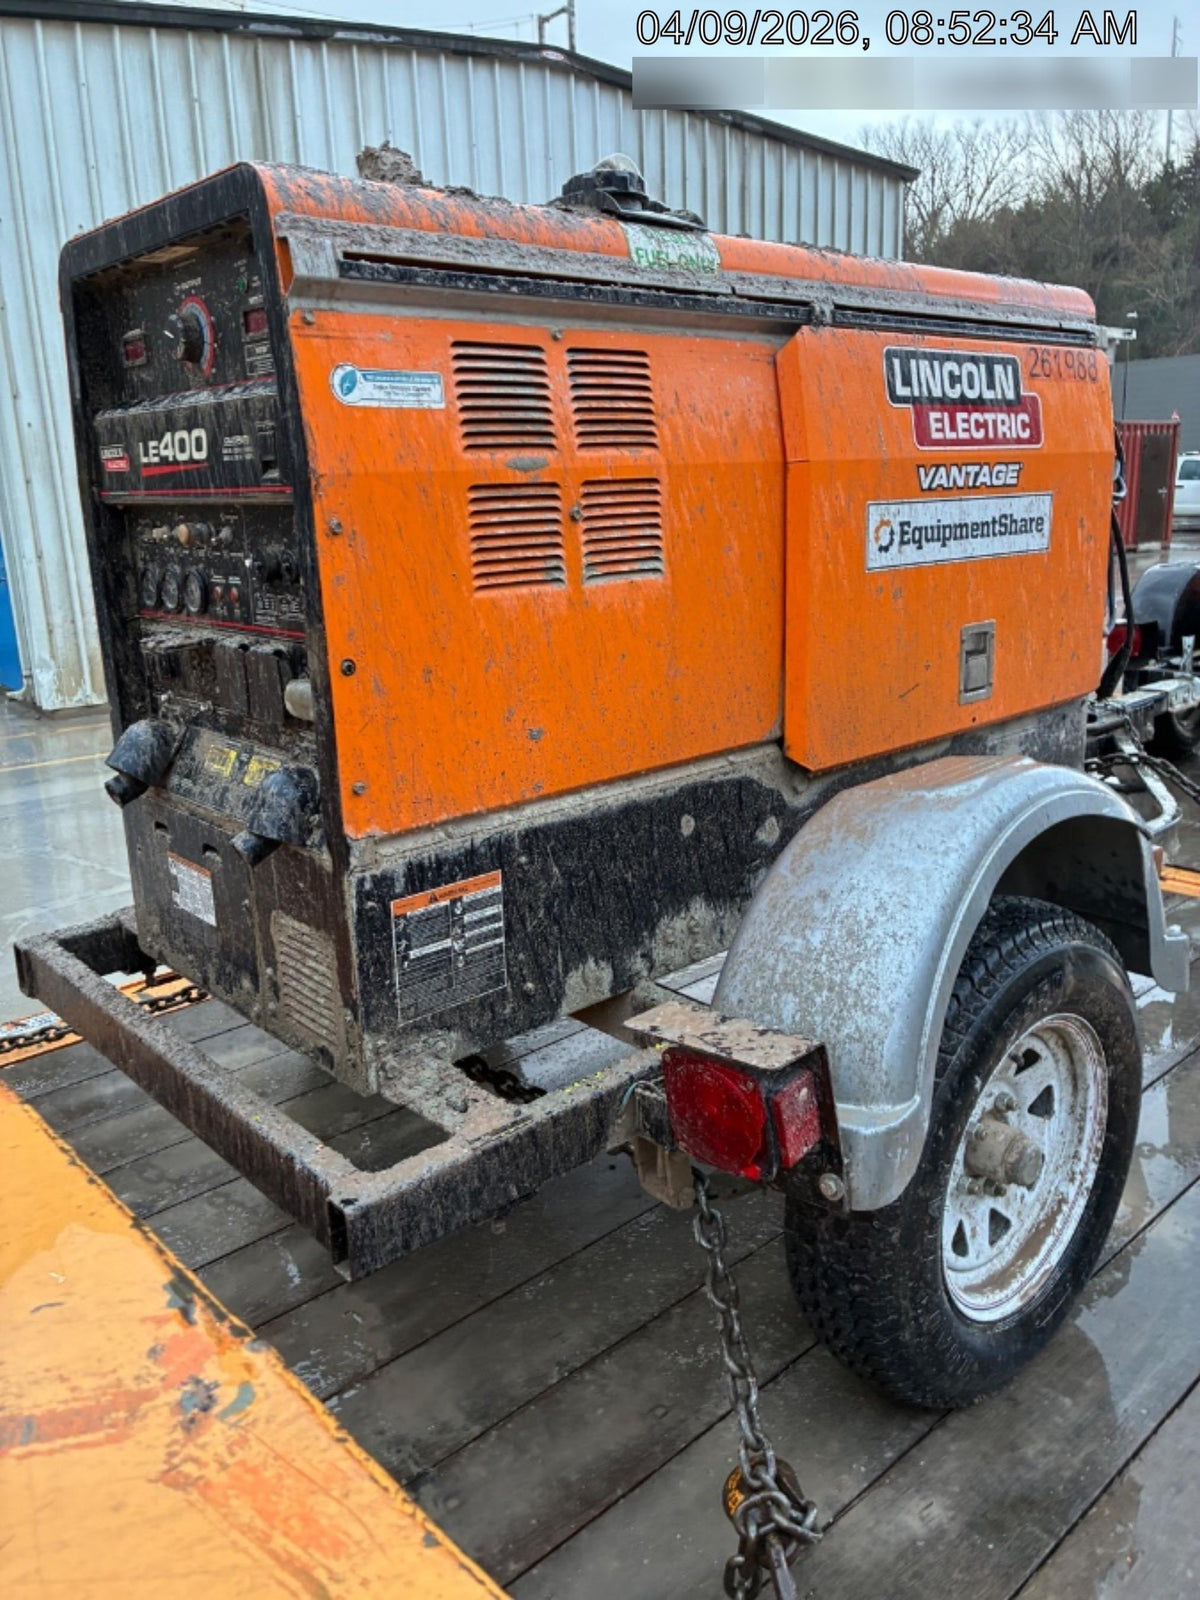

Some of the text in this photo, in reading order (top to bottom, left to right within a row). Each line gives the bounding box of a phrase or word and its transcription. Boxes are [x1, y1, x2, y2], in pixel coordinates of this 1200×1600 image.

[892, 357, 1016, 400] LINCOLN
[1028, 347, 1098, 382] 261988
[928, 412, 1031, 440] ELECTRIC
[138, 428, 208, 463] LE400
[918, 462, 1021, 490] VANTAGE
[899, 513, 1045, 549] EquipmentShare
